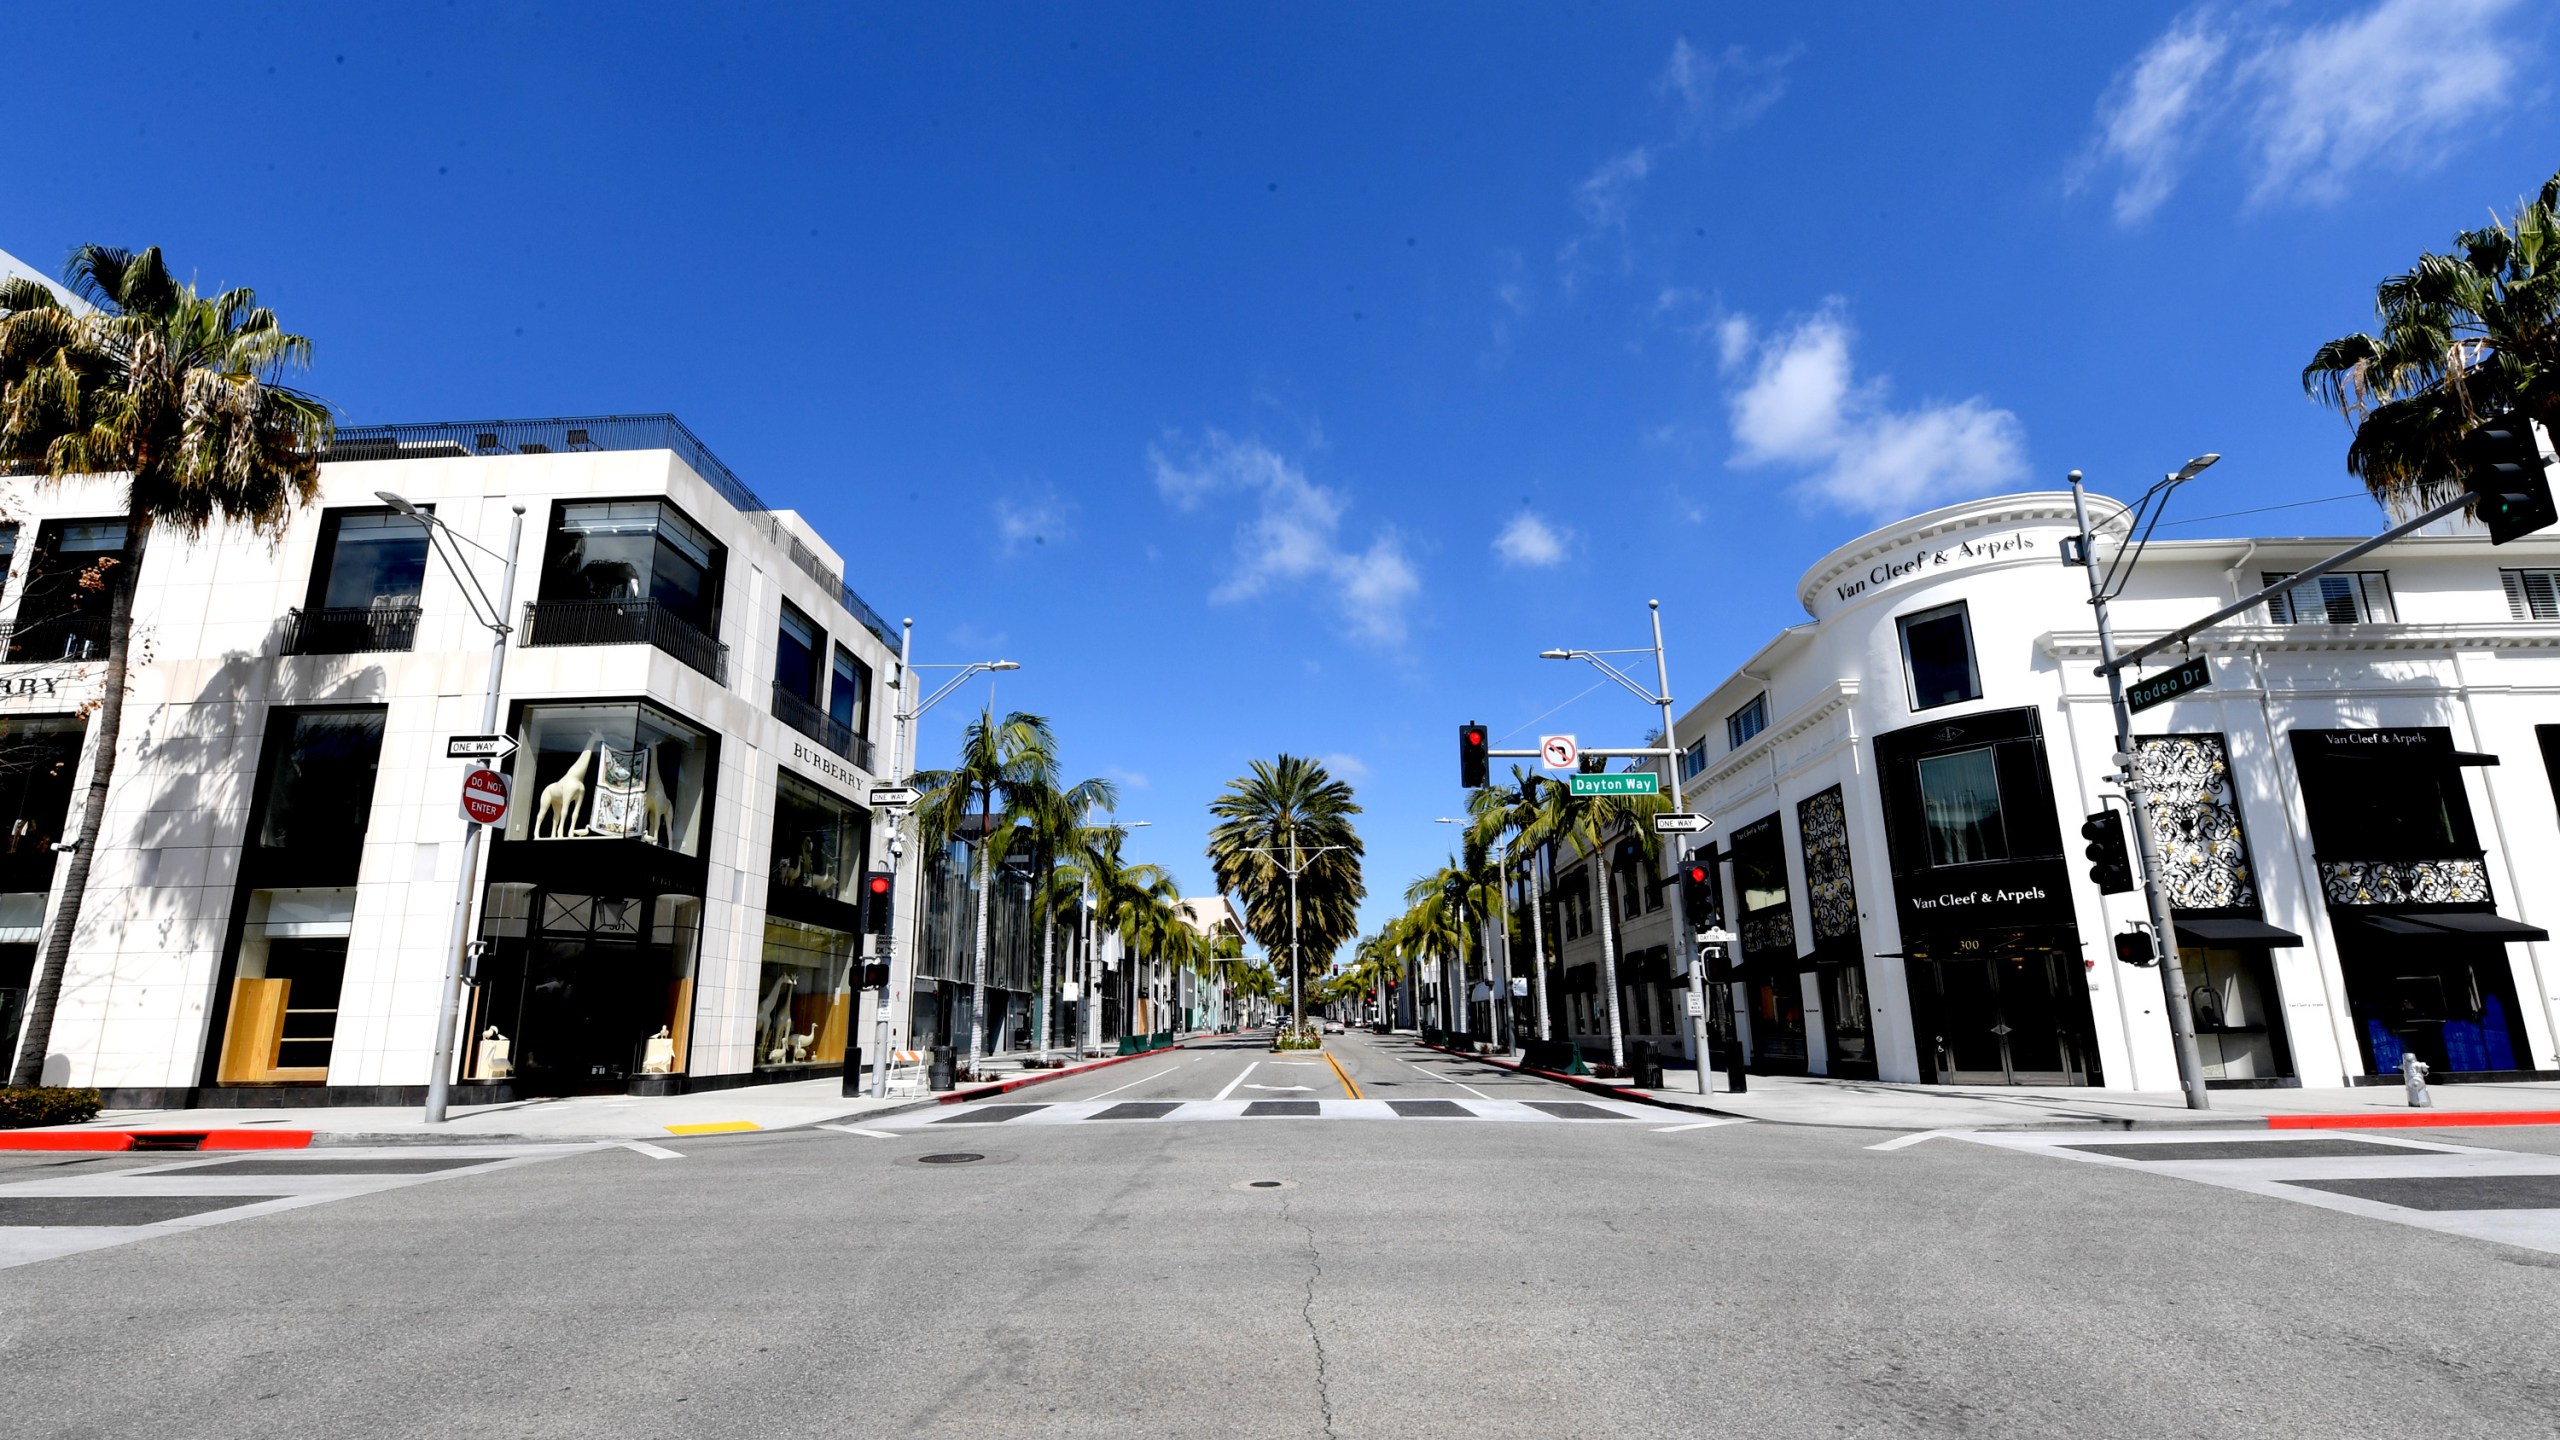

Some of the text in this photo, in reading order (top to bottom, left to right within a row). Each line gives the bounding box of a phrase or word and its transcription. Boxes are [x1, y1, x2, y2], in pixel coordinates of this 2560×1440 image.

[1836, 532, 2035, 601] Van Cleef & Arpels
[2133, 668, 2201, 706] Rodeo Dr
[2325, 732, 2427, 746] Van Cleef & Arpels
[453, 742, 495, 752] ONE WAY
[793, 742, 864, 791] BURBERRY
[471, 776, 502, 793] DO NOT
[1576, 778, 1651, 792] Dayton Way
[471, 801, 497, 816] ENTER
[1660, 820, 1674, 828] ONE
[1912, 886, 2046, 909] Van Cleef & Arpels
[1960, 940, 1980, 950] 300
